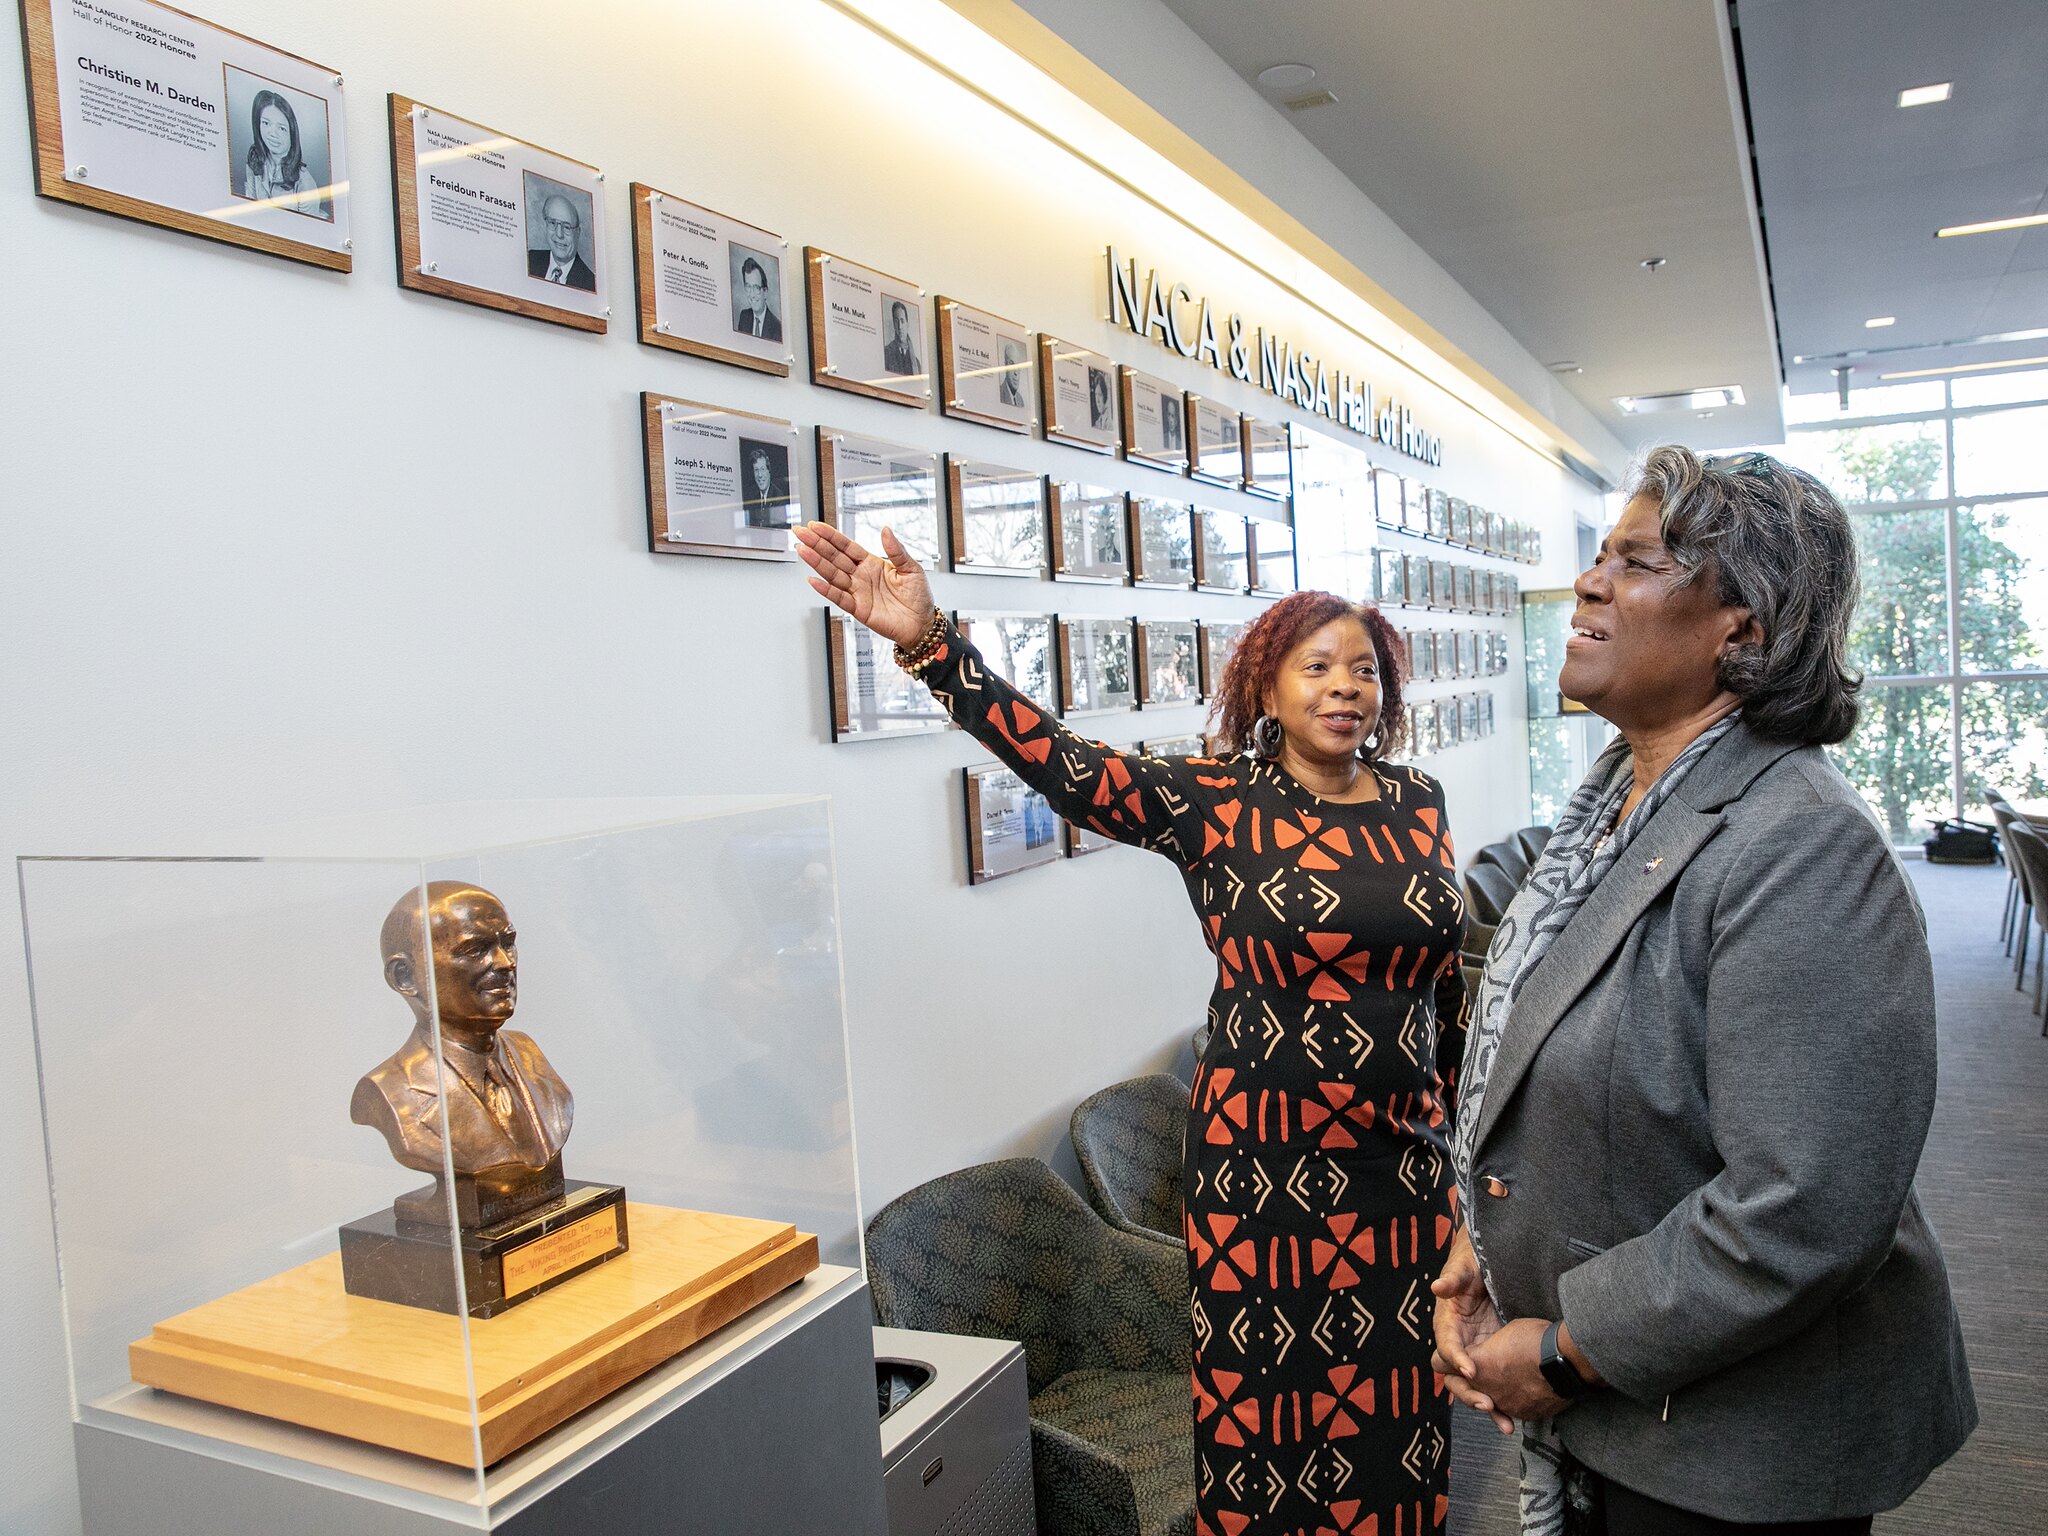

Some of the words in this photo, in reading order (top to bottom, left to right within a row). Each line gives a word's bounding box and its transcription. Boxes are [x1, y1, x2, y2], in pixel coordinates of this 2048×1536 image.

[73, 8, 91, 21] Hall
[93, 17, 102, 25] of
[105, 20, 133, 36] Honor
[135, 31, 158, 46] 2022
[160, 40, 197, 60] Honoree
[95, 6, 129, 23] LANGLEY
[131, 19, 167, 38] RESEARCH
[169, 34, 195, 48] CENTER
[77, 56, 142, 88] Christine
[146, 79, 164, 96] M.
[168, 86, 216, 113] Darden
[86, 81, 117, 95] recognition
[124, 94, 152, 107] exemplary
[152, 103, 174, 113] technical
[175, 111, 207, 125] contributions
[80, 87, 109, 99] supersonic
[110, 96, 129, 106] aircraft
[144, 108, 166, 117] research
[177, 118, 204, 131] trailblazing
[204, 127, 220, 135] career
[81, 101, 101, 110] African
[102, 108, 126, 119] American
[127, 117, 147, 125] woman
[154, 124, 169, 133] NASA
[170, 130, 189, 140] Langley
[117, 105, 130, 113] from
[195, 130, 206, 138] first
[92, 111, 111, 122] federal
[112, 119, 147, 134] management
[166, 135, 182, 144] Senior
[183, 140, 207, 151] Executive
[427, 129, 441, 138] NASA
[442, 134, 463, 145] LANGLEY
[488, 150, 506, 160] CENTER
[428, 136, 439, 147] Hall
[482, 156, 506, 170] Honoree
[430, 174, 477, 199] Fereidoun
[479, 190, 517, 211] Farassat
[662, 248, 680, 261] Peter
[681, 254, 688, 264] A.
[688, 257, 709, 270] Gnoffo
[831, 302, 843, 313] Max
[1106, 245, 1222, 369] NACA
[1227, 312, 1253, 384] &
[1258, 327, 1333, 419] NASA
[1336, 370, 1375, 438] Hall
[1378, 396, 1397, 447] of
[710, 432, 727, 440] Honoree
[674, 456, 699, 470] Joseph
[699, 460, 706, 469] S.
[706, 461, 733, 474] Heyman
[510, 1265, 527, 1278] THE
[528, 1251, 556, 1269] VIKING
[558, 1234, 592, 1255] PROJECT
[594, 1225, 613, 1240] TEAM
[533, 1228, 577, 1254] PRESENTED
[580, 1222, 591, 1233] TO
[543, 1263, 562, 1276] APRIL
